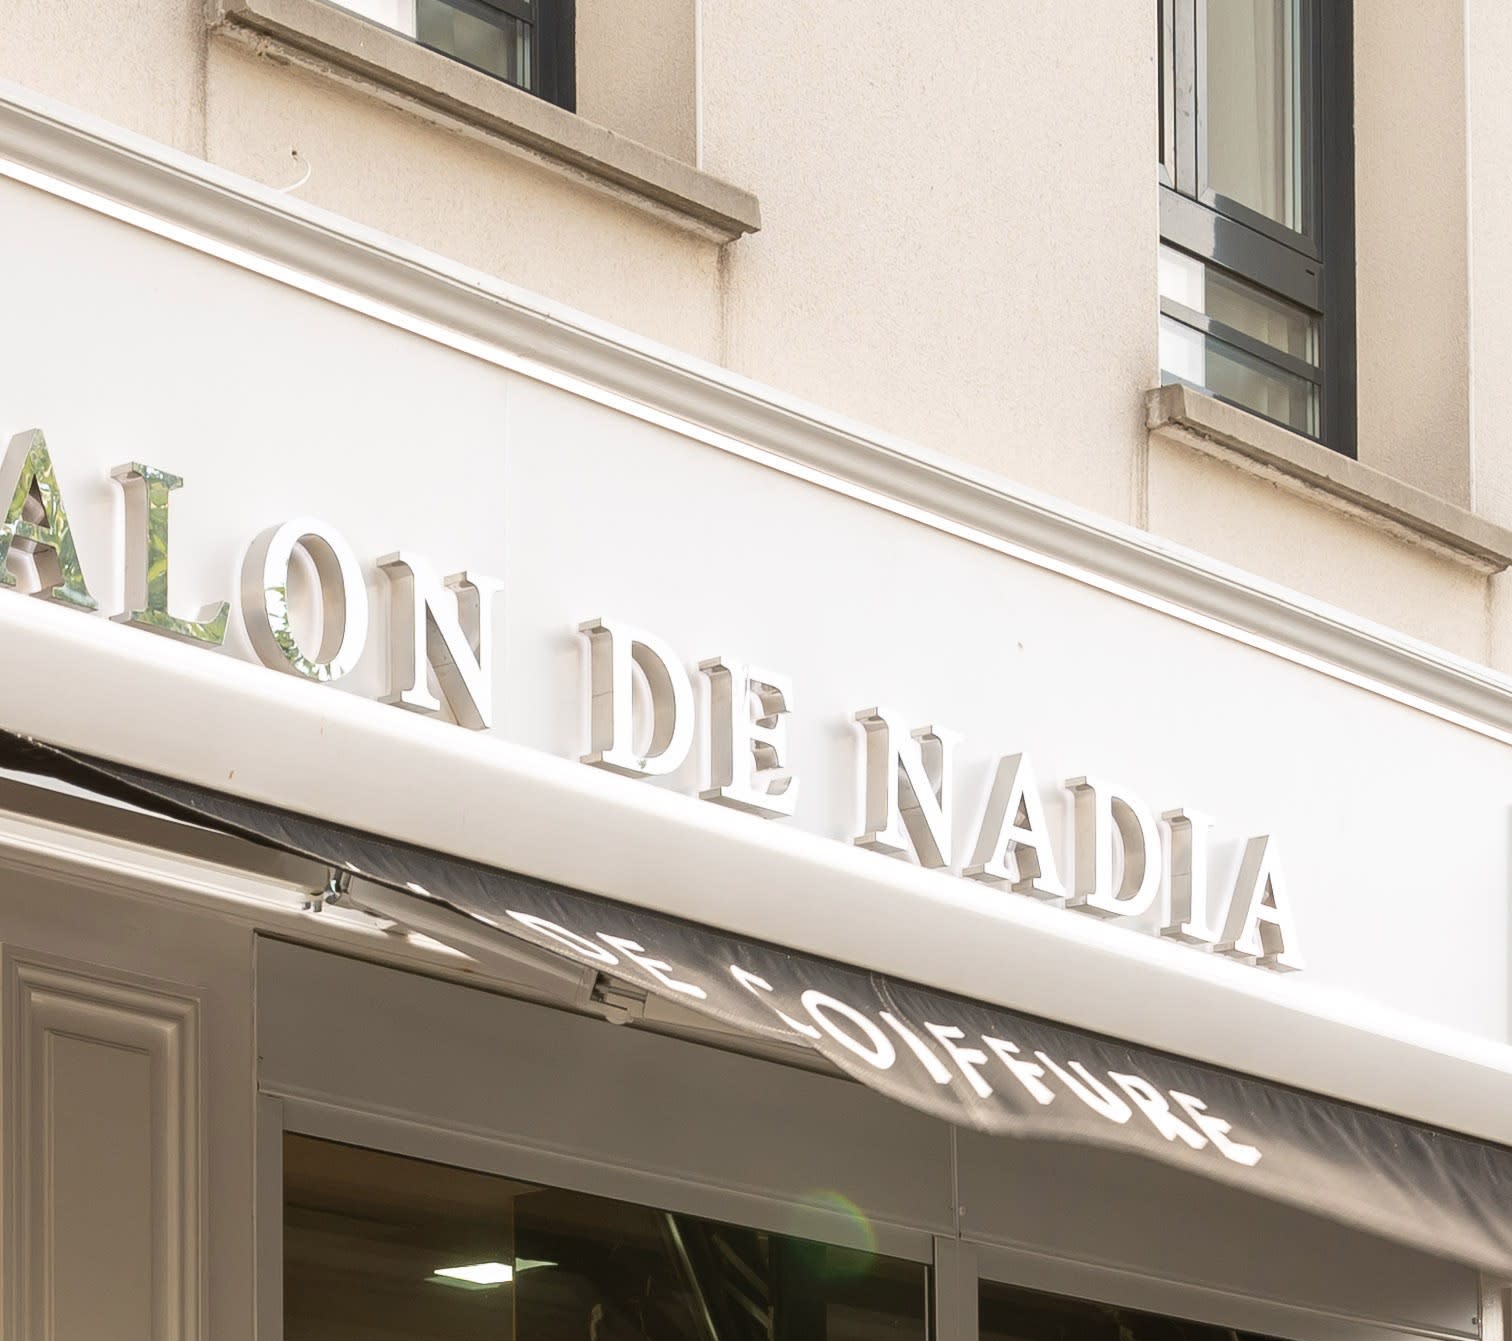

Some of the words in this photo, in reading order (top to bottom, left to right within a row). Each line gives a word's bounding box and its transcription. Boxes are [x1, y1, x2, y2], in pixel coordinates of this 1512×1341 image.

[576, 616, 797, 820] DE
[852, 705, 1304, 972] NADIA
[505, 909, 708, 999] DE
[729, 964, 1263, 1168] COIFFURE
